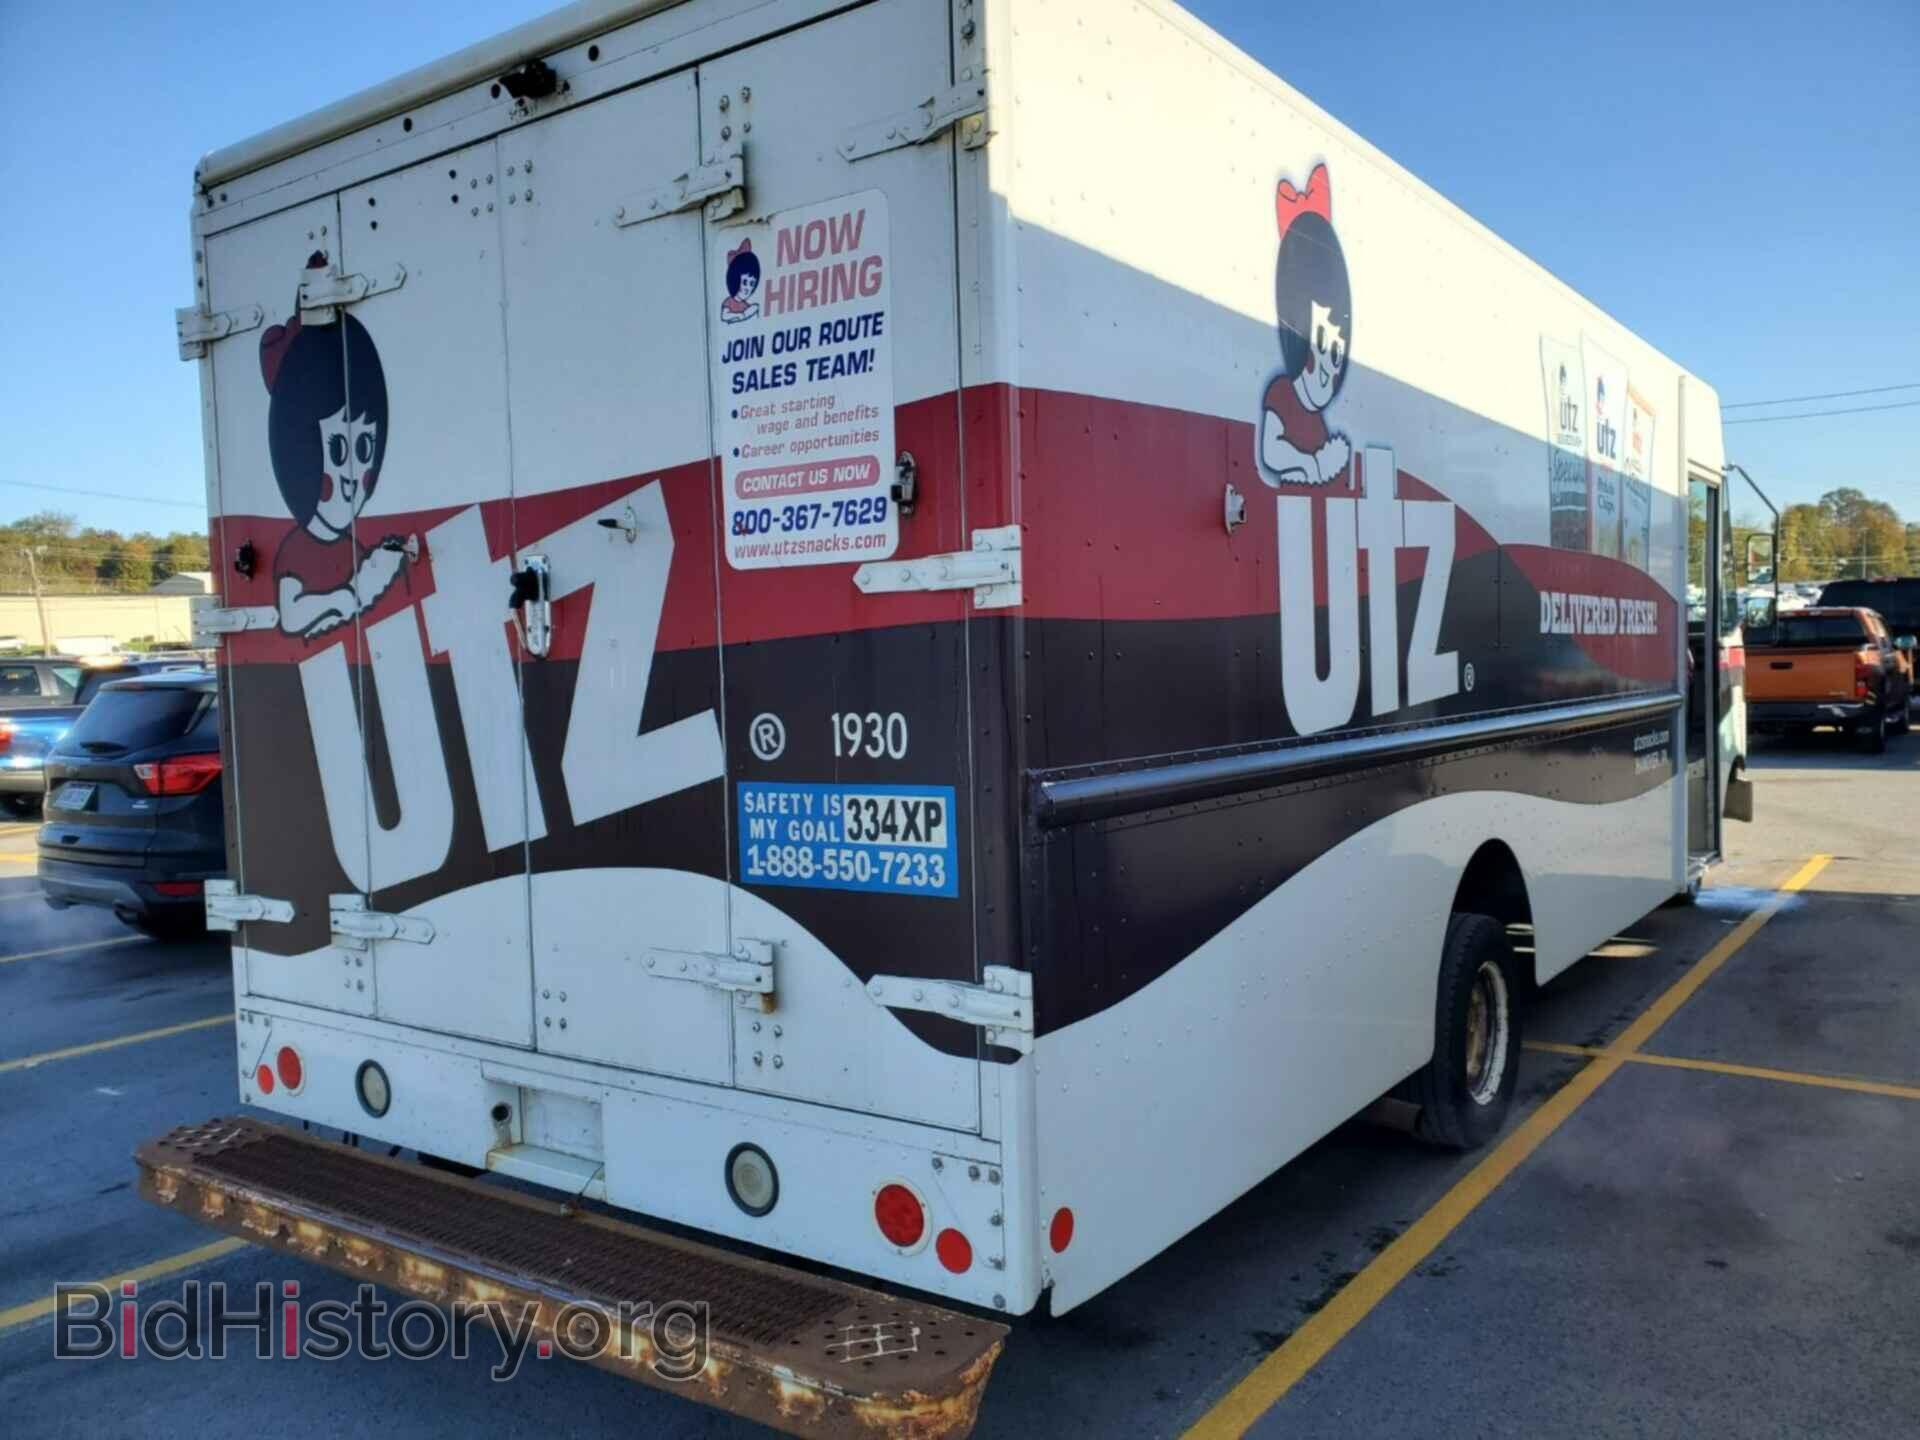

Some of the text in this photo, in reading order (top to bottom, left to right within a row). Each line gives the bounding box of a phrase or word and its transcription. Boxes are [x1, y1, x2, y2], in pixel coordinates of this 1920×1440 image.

[776, 208, 866, 267] NOW
[763, 254, 883, 318] HIRING
[722, 312, 884, 364] JOIN OUR ROUTE
[732, 348, 875, 395] SALES TEAM!
[740, 394, 836, 420] Great starting
[756, 404, 879, 436] wage and benefits
[741, 429, 880, 459] Career opportunities
[742, 463, 871, 493] CONTACT US NOW
[732, 496, 887, 537] 800-367-7629
[734, 532, 886, 559] www.utzsnacks.com
[1540, 591, 1617, 635] DELIVERED
[831, 711, 908, 760] 1930
[744, 791, 842, 816] SAFETY IS
[846, 797, 942, 843] 334XP
[749, 818, 840, 843] MY GOAL
[747, 844, 945, 888] 1-888-550-7233
